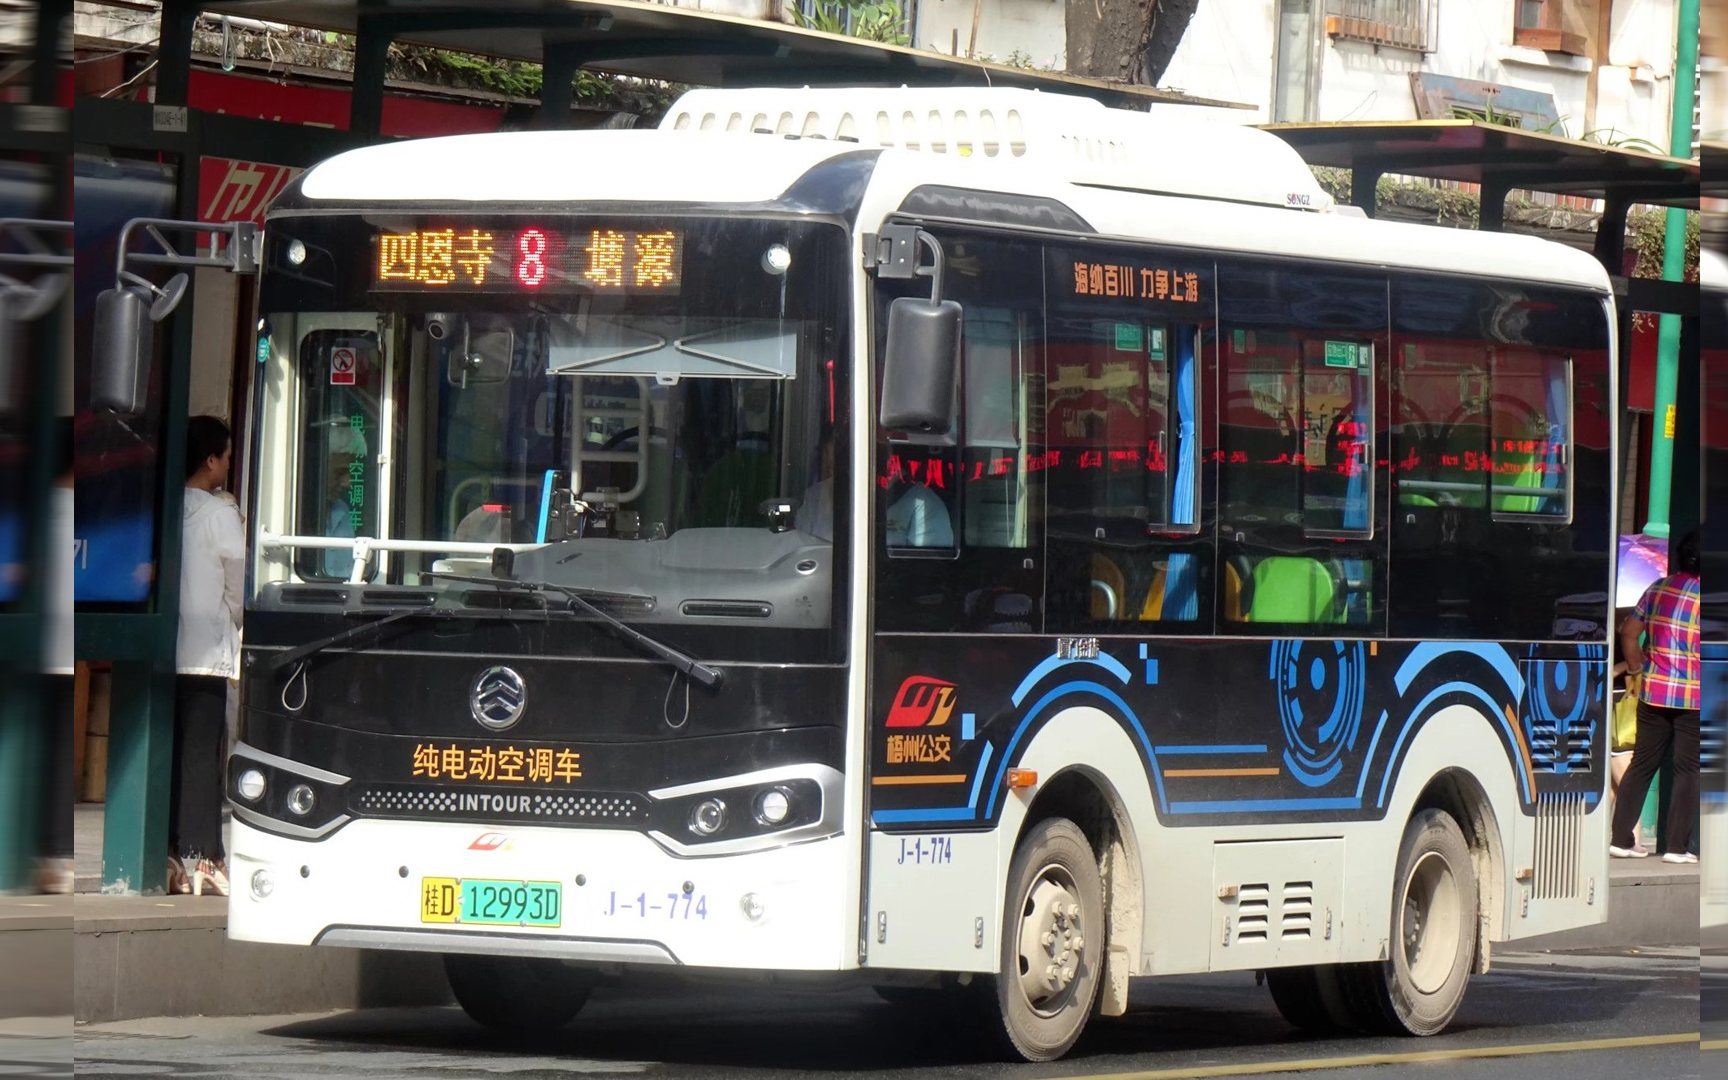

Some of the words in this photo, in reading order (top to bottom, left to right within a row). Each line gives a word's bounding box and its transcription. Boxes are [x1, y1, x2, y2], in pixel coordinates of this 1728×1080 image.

[1287, 193, 1311, 206] SONGZ
[379, 229, 494, 284] 四恩寺
[518, 229, 546, 285] 8
[585, 230, 675, 286] 塘源
[1074, 261, 1134, 297] 海纳百川
[1140, 267, 1198, 302] 力争上游
[412, 743, 583, 784] 纯电动空调车
[886, 734, 951, 763] 梧州公交
[459, 793, 532, 813] INTOUR
[897, 836, 952, 865] J-1-774
[469, 885, 560, 921] 12993D
[603, 891, 708, 921] J-1-774
